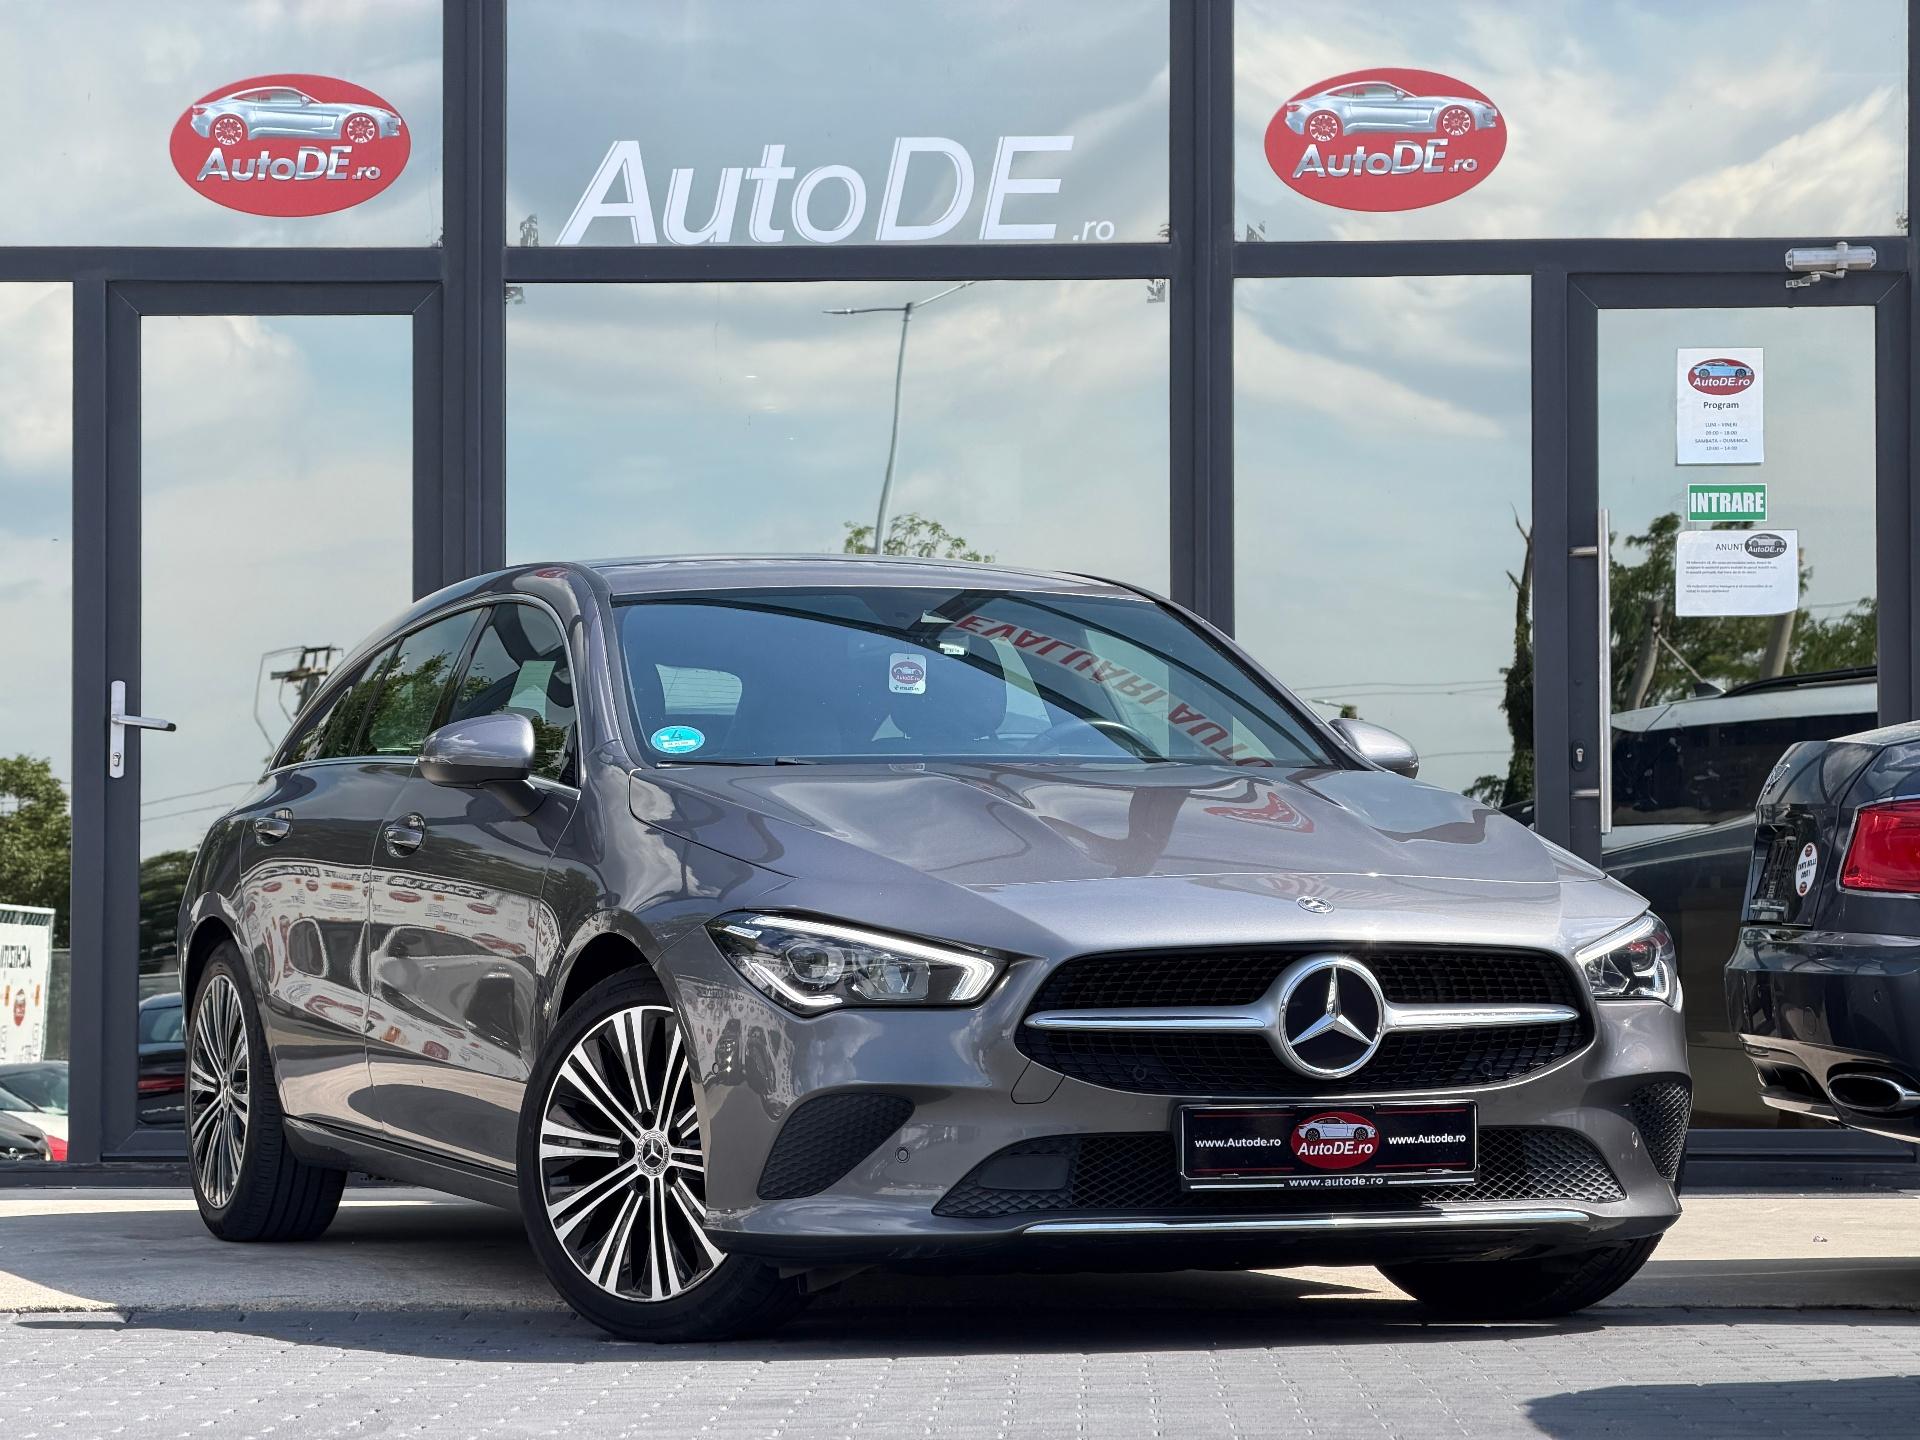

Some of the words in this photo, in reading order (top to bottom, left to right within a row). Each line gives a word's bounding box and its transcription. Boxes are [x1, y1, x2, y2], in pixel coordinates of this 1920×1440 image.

[1692, 377, 1751, 387] AutoDE.ro
[1703, 401, 1740, 411] Program
[1690, 492, 1765, 513] INTRARE
[1747, 545, 1785, 553] AutoDE.ro
[1194, 1136, 1281, 1148] www.Autode.ro
[1388, 1133, 1467, 1145] www.Autode.ro
[1297, 1140, 1374, 1156] AutoDE.ro
[1288, 1176, 1384, 1187] www.autode.ro
